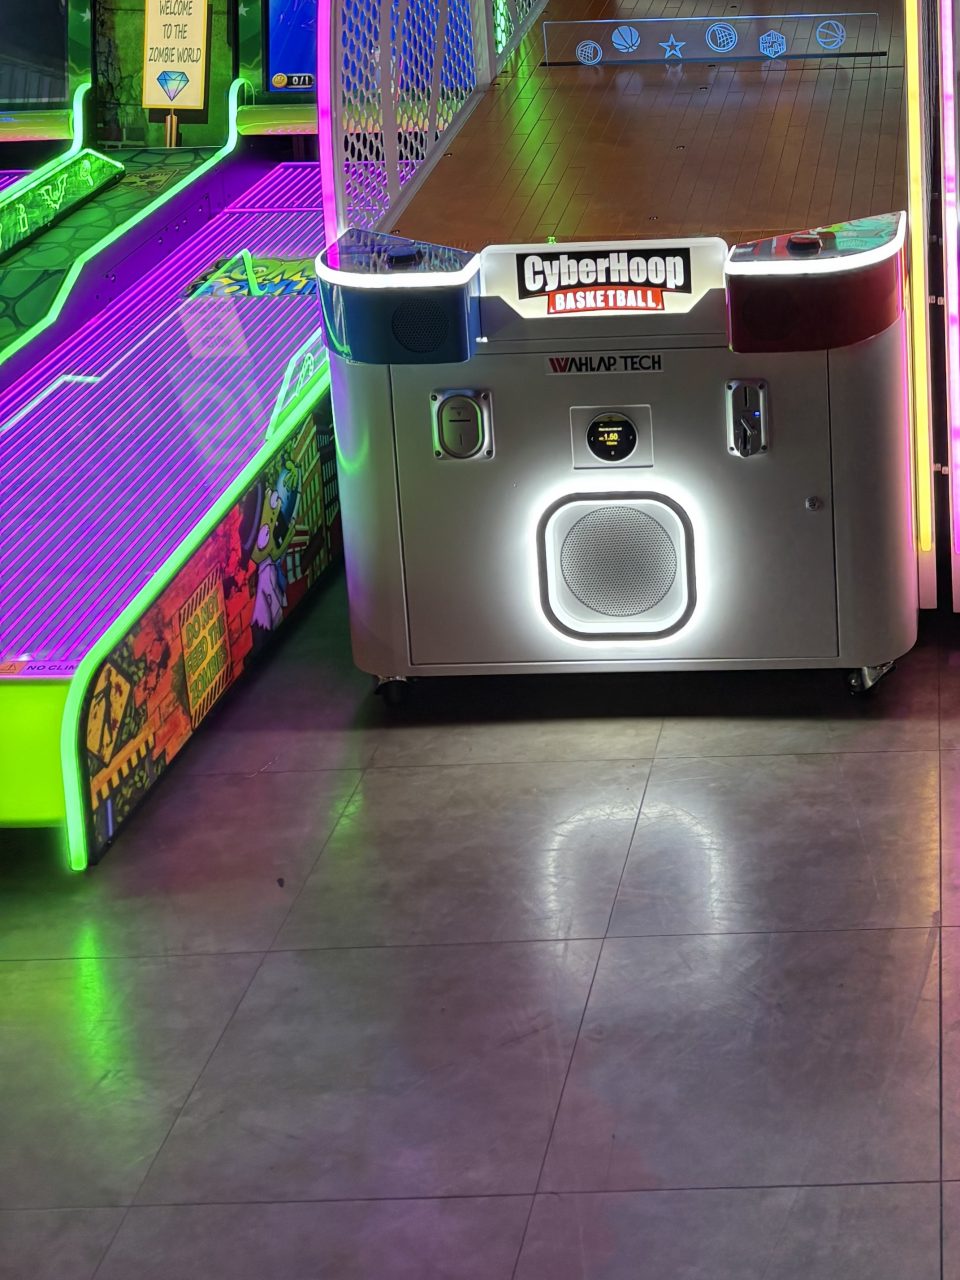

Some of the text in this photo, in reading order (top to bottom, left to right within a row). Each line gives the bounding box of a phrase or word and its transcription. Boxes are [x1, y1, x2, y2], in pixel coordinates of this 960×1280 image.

[159, 0, 193, 16] WELCOME
[162, 23, 188, 40] TO THE
[148, 46, 202, 64] ZOMBIE WORLD
[292, 76, 309, 86] 0/1
[523, 253, 685, 296] CyberHoop
[554, 288, 662, 313] BASKETBALL
[620, 355, 662, 372] TECH
[185, 588, 219, 650] DO NOT
[185, 636, 209, 674] FEED
